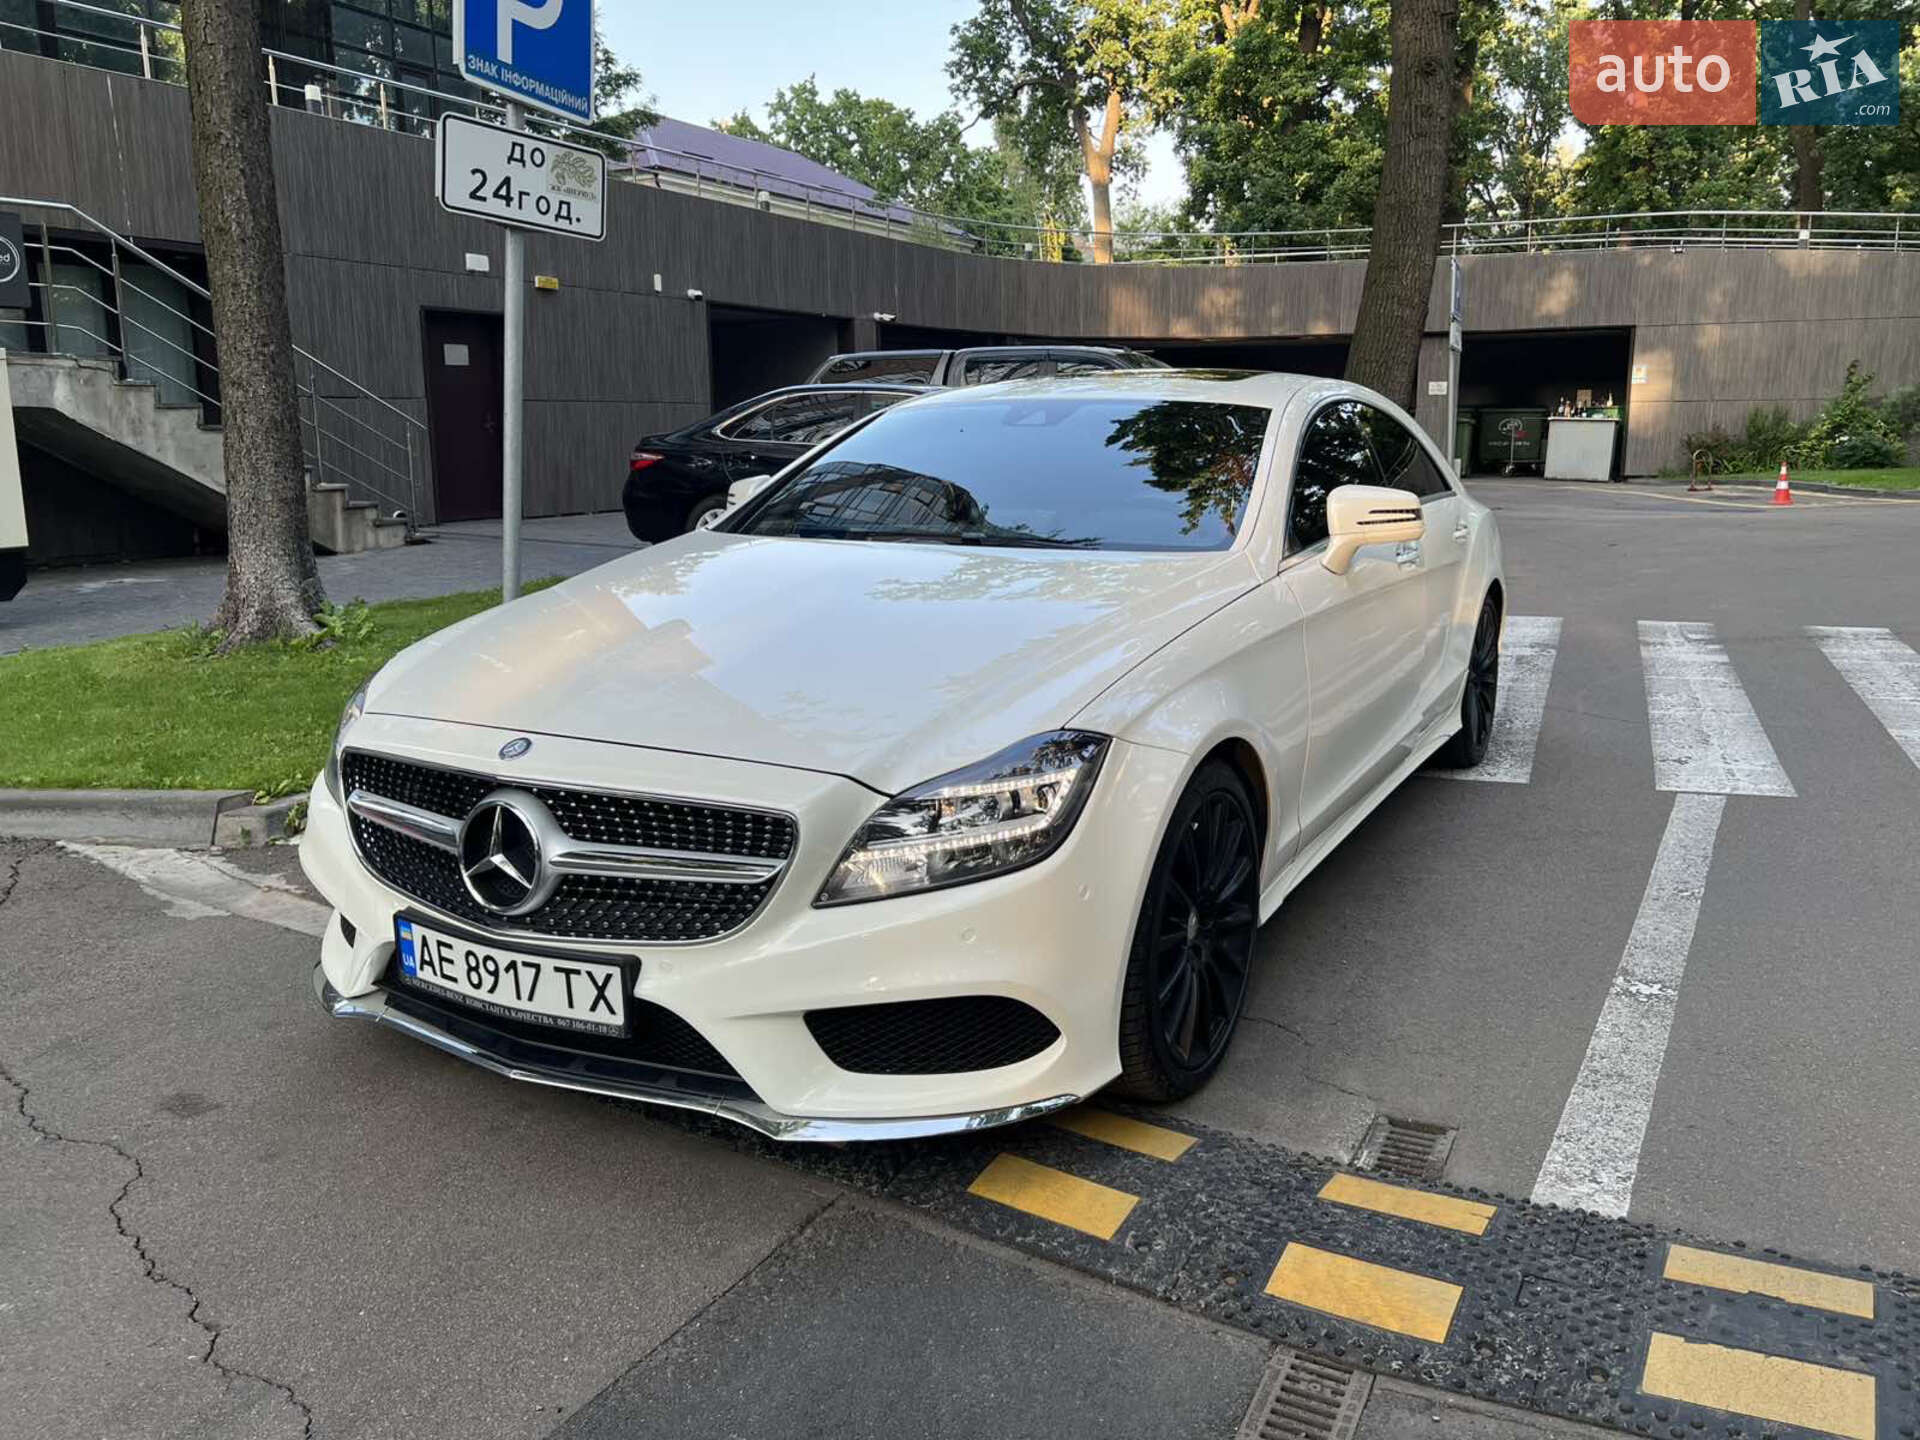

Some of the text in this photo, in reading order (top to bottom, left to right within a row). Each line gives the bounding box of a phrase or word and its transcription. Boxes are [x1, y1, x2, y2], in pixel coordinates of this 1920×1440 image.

[467, 54, 498, 79] ЗНАК
[402, 954, 415, 968] UA
[419, 934, 617, 1016] AE 8917 TX
